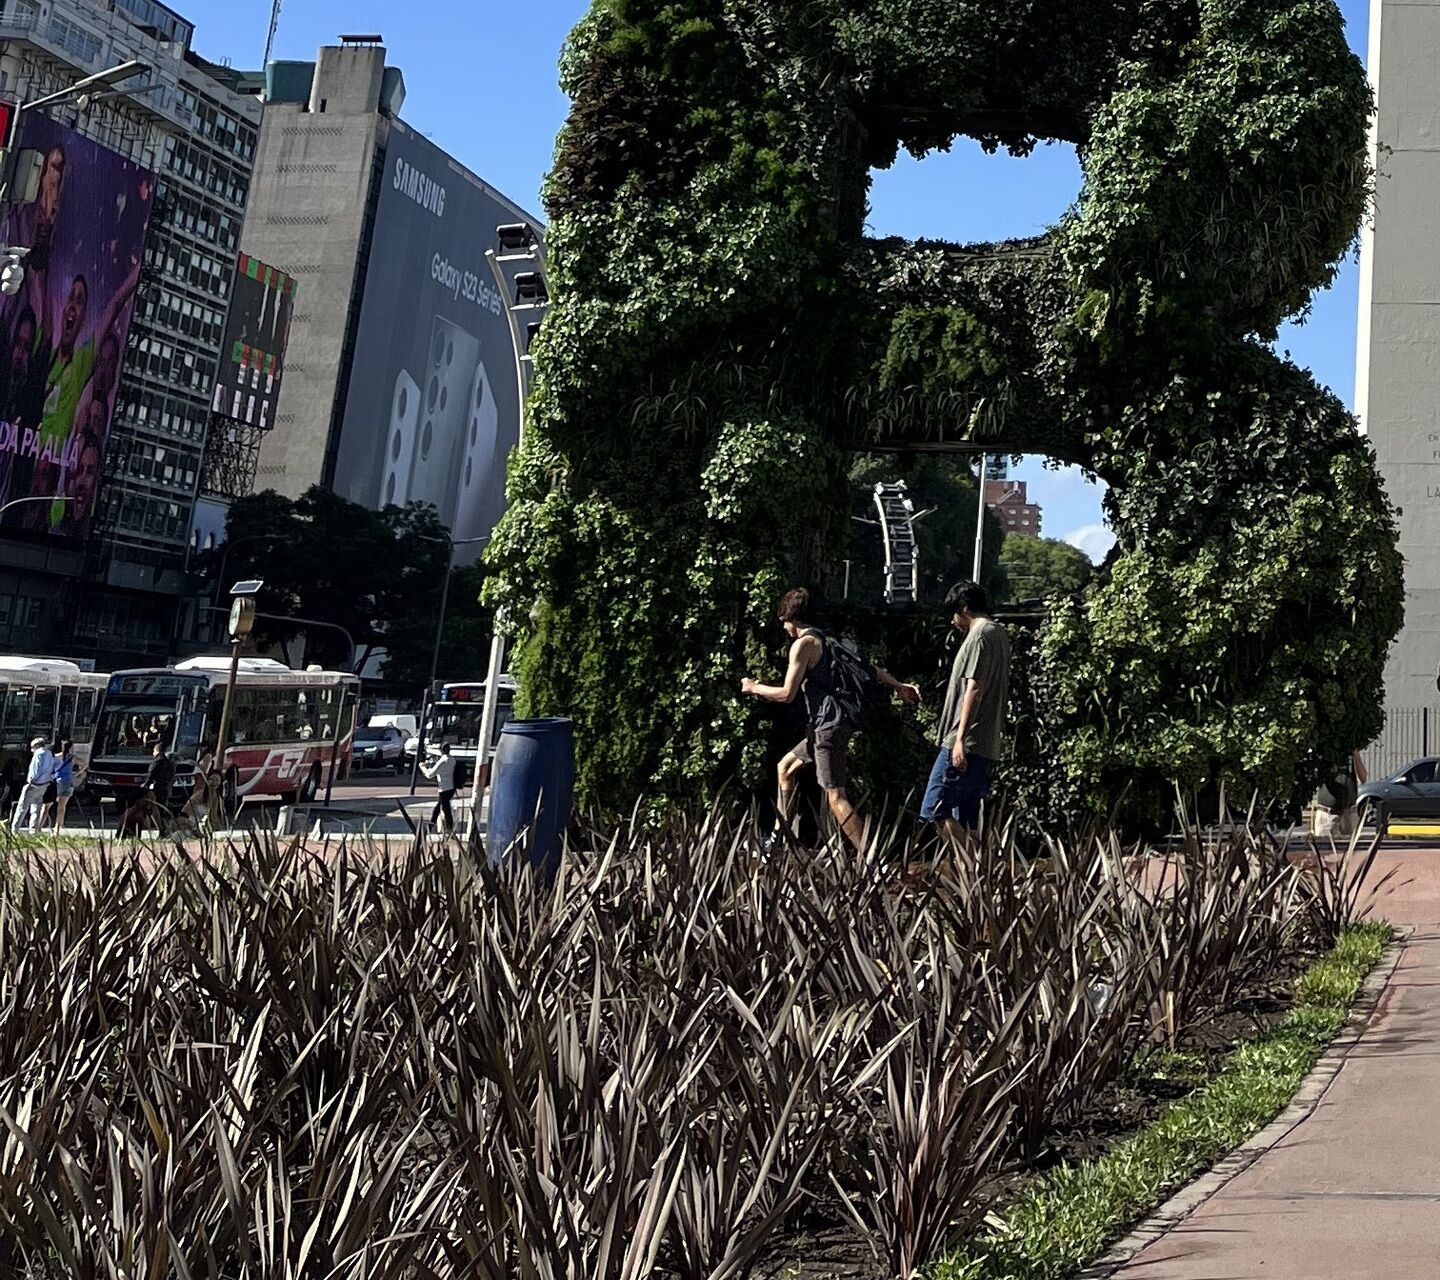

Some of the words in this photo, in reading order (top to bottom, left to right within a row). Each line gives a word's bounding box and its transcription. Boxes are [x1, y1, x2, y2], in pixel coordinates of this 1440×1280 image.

[393, 157, 446, 217] SAMSUNG
[431, 252, 463, 301] Galaxy
[462, 270, 478, 302] S23
[476, 279, 502, 316] Series
[1428, 434, 1439, 442] EN
[1426, 486, 1440, 499] LA
[277, 751, 305, 779] 67
